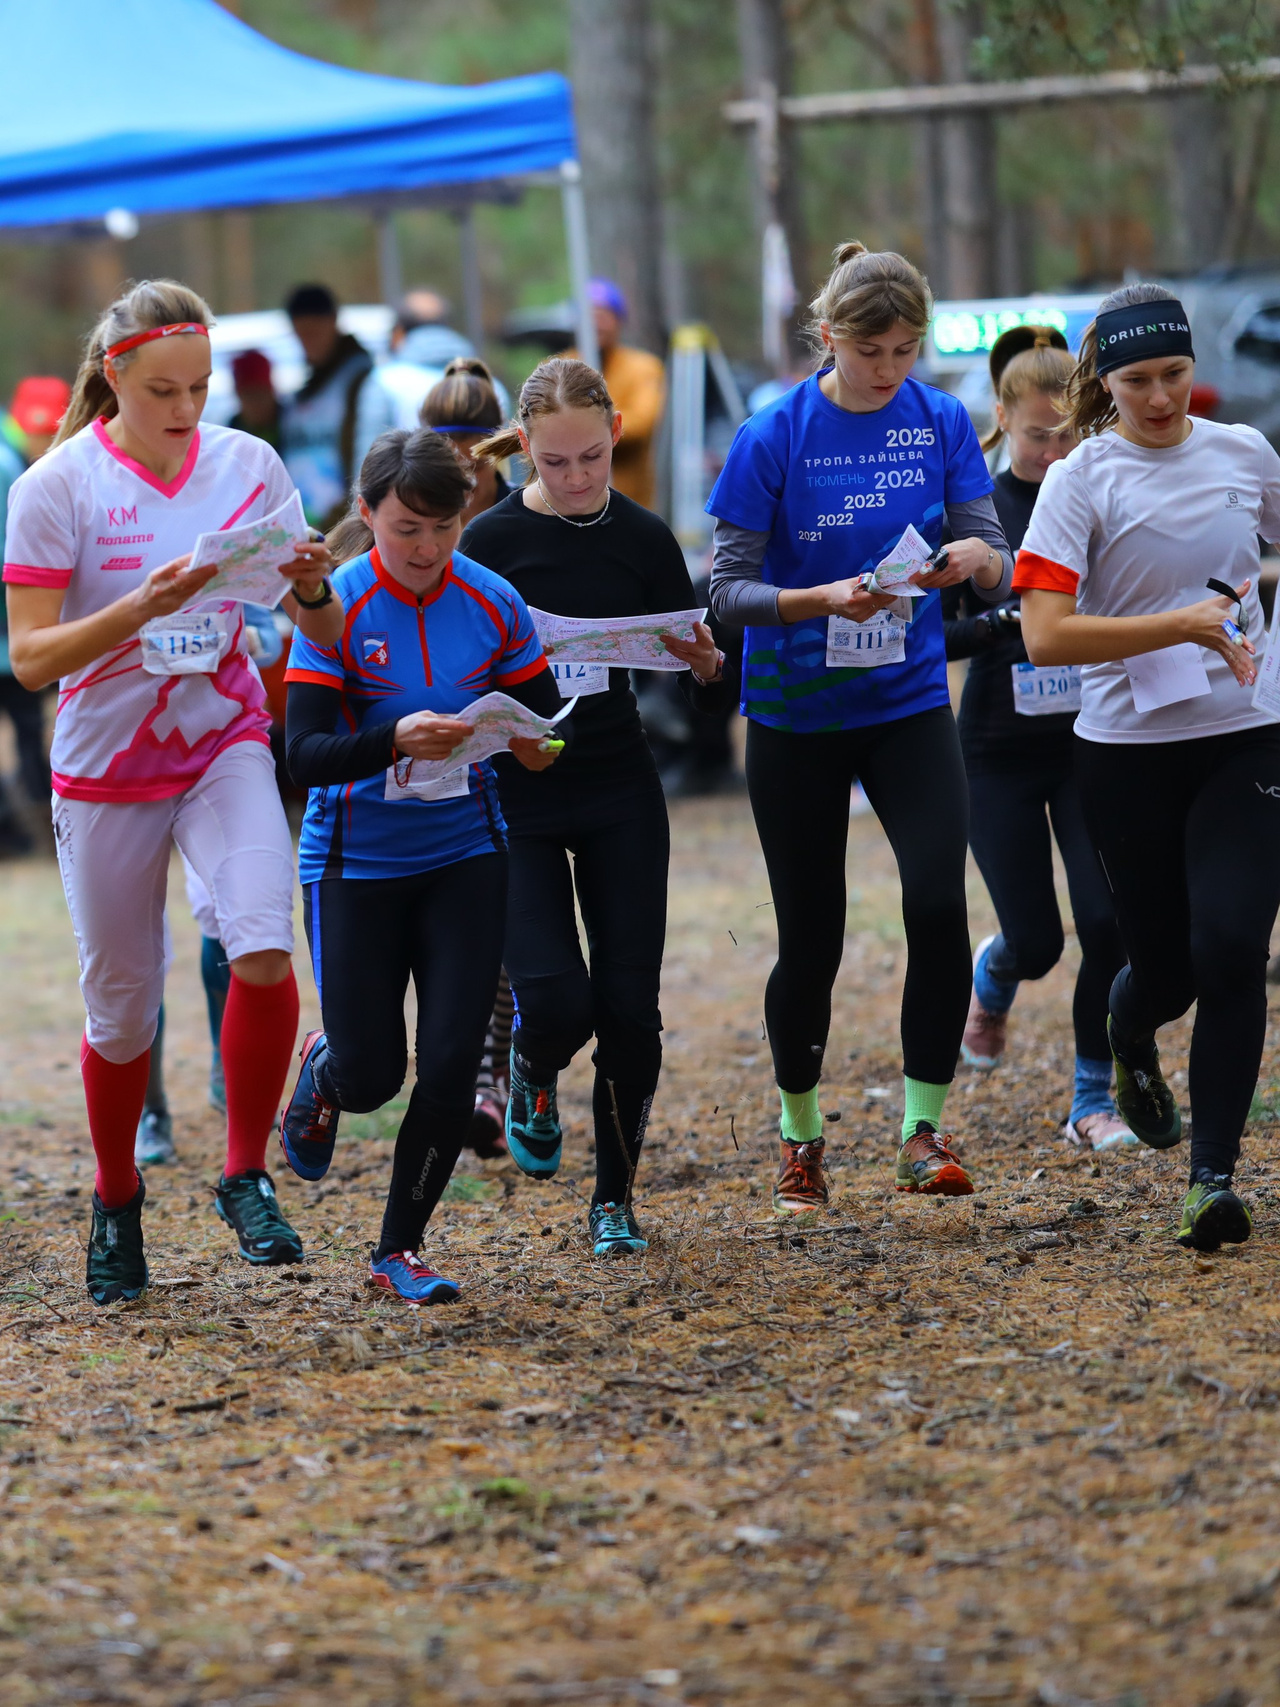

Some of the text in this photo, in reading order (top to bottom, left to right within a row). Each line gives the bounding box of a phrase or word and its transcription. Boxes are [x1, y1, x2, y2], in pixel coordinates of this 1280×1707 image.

[1109, 322, 1189, 344] ORIENTEAM
[886, 427, 935, 448] 2025
[804, 451, 924, 468] ТРОПА ЗАЙЦЕВА
[806, 473, 866, 488] ТЮМЕНЬ
[874, 468, 926, 490] 2024
[844, 492, 886, 510] 2023
[817, 513, 854, 527] 2022
[96, 533, 155, 546] noname
[798, 530, 822, 542] 2021
[168, 635, 203, 655] 115
[854, 630, 884, 650] 111
[1039, 677, 1068, 695] 120
